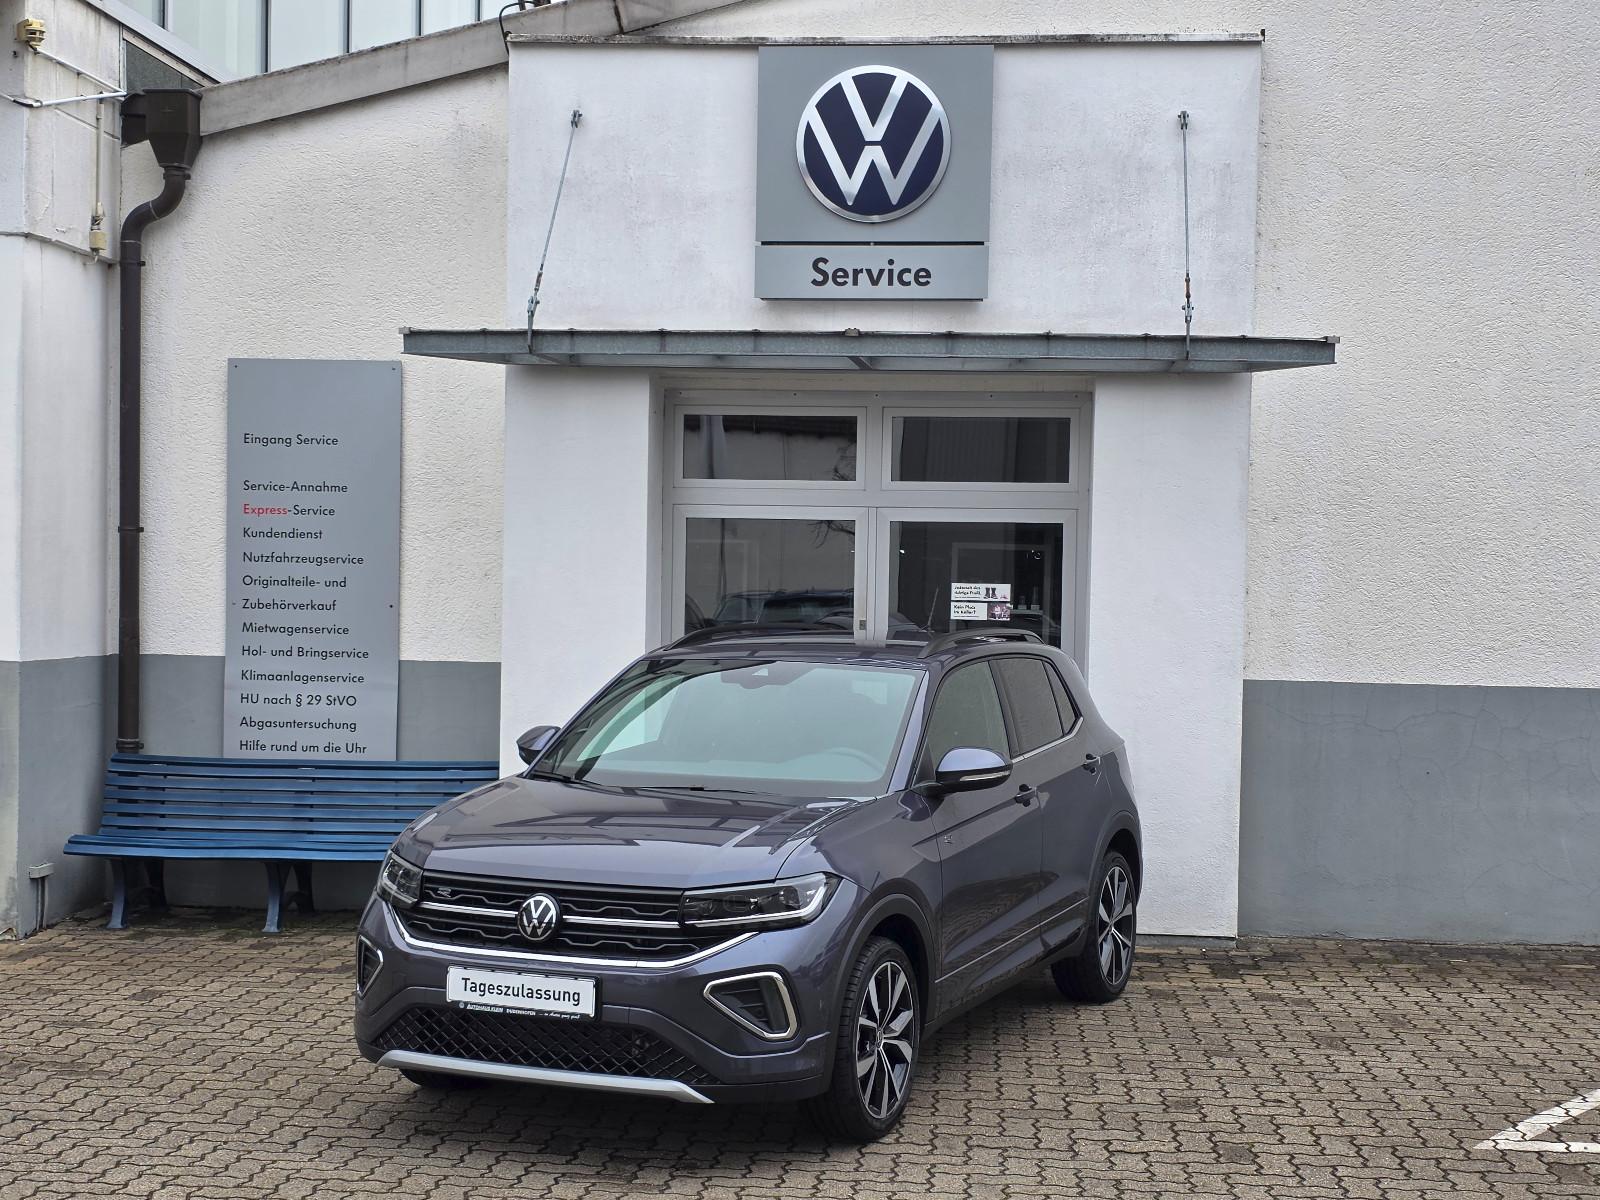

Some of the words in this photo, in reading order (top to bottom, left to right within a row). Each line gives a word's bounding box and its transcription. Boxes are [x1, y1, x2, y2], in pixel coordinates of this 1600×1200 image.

[811, 257, 932, 287] Service
[243, 433, 292, 447] Eingang
[296, 434, 339, 445] Service
[243, 480, 348, 493] Service-Annahme
[243, 503, 336, 517] Express-Service
[243, 527, 323, 539] Kundendienst
[242, 552, 364, 567] Nutzfahrzeugservice
[242, 575, 320, 588] Originalteile-
[324, 576, 347, 588] und
[242, 598, 337, 611] Zubehörverkauf
[241, 622, 350, 636] Mietwagenservice
[241, 645, 267, 657] Hol-
[271, 646, 293, 657] und
[297, 646, 369, 660] Bringservice
[241, 669, 365, 684] Klimaanlagenservice
[240, 693, 259, 704] HU
[263, 694, 292, 705] nach
[295, 693, 302, 707] §
[306, 695, 322, 706] 29
[326, 695, 357, 707] StVO
[239, 716, 357, 732] Abgasuntersuchung
[240, 740, 267, 752] Hilfe
[270, 741, 297, 752] rund
[301, 745, 319, 753] um
[323, 741, 341, 753] die
[345, 742, 367, 754] Uhr
[461, 977, 581, 1007] Tageszulassung
